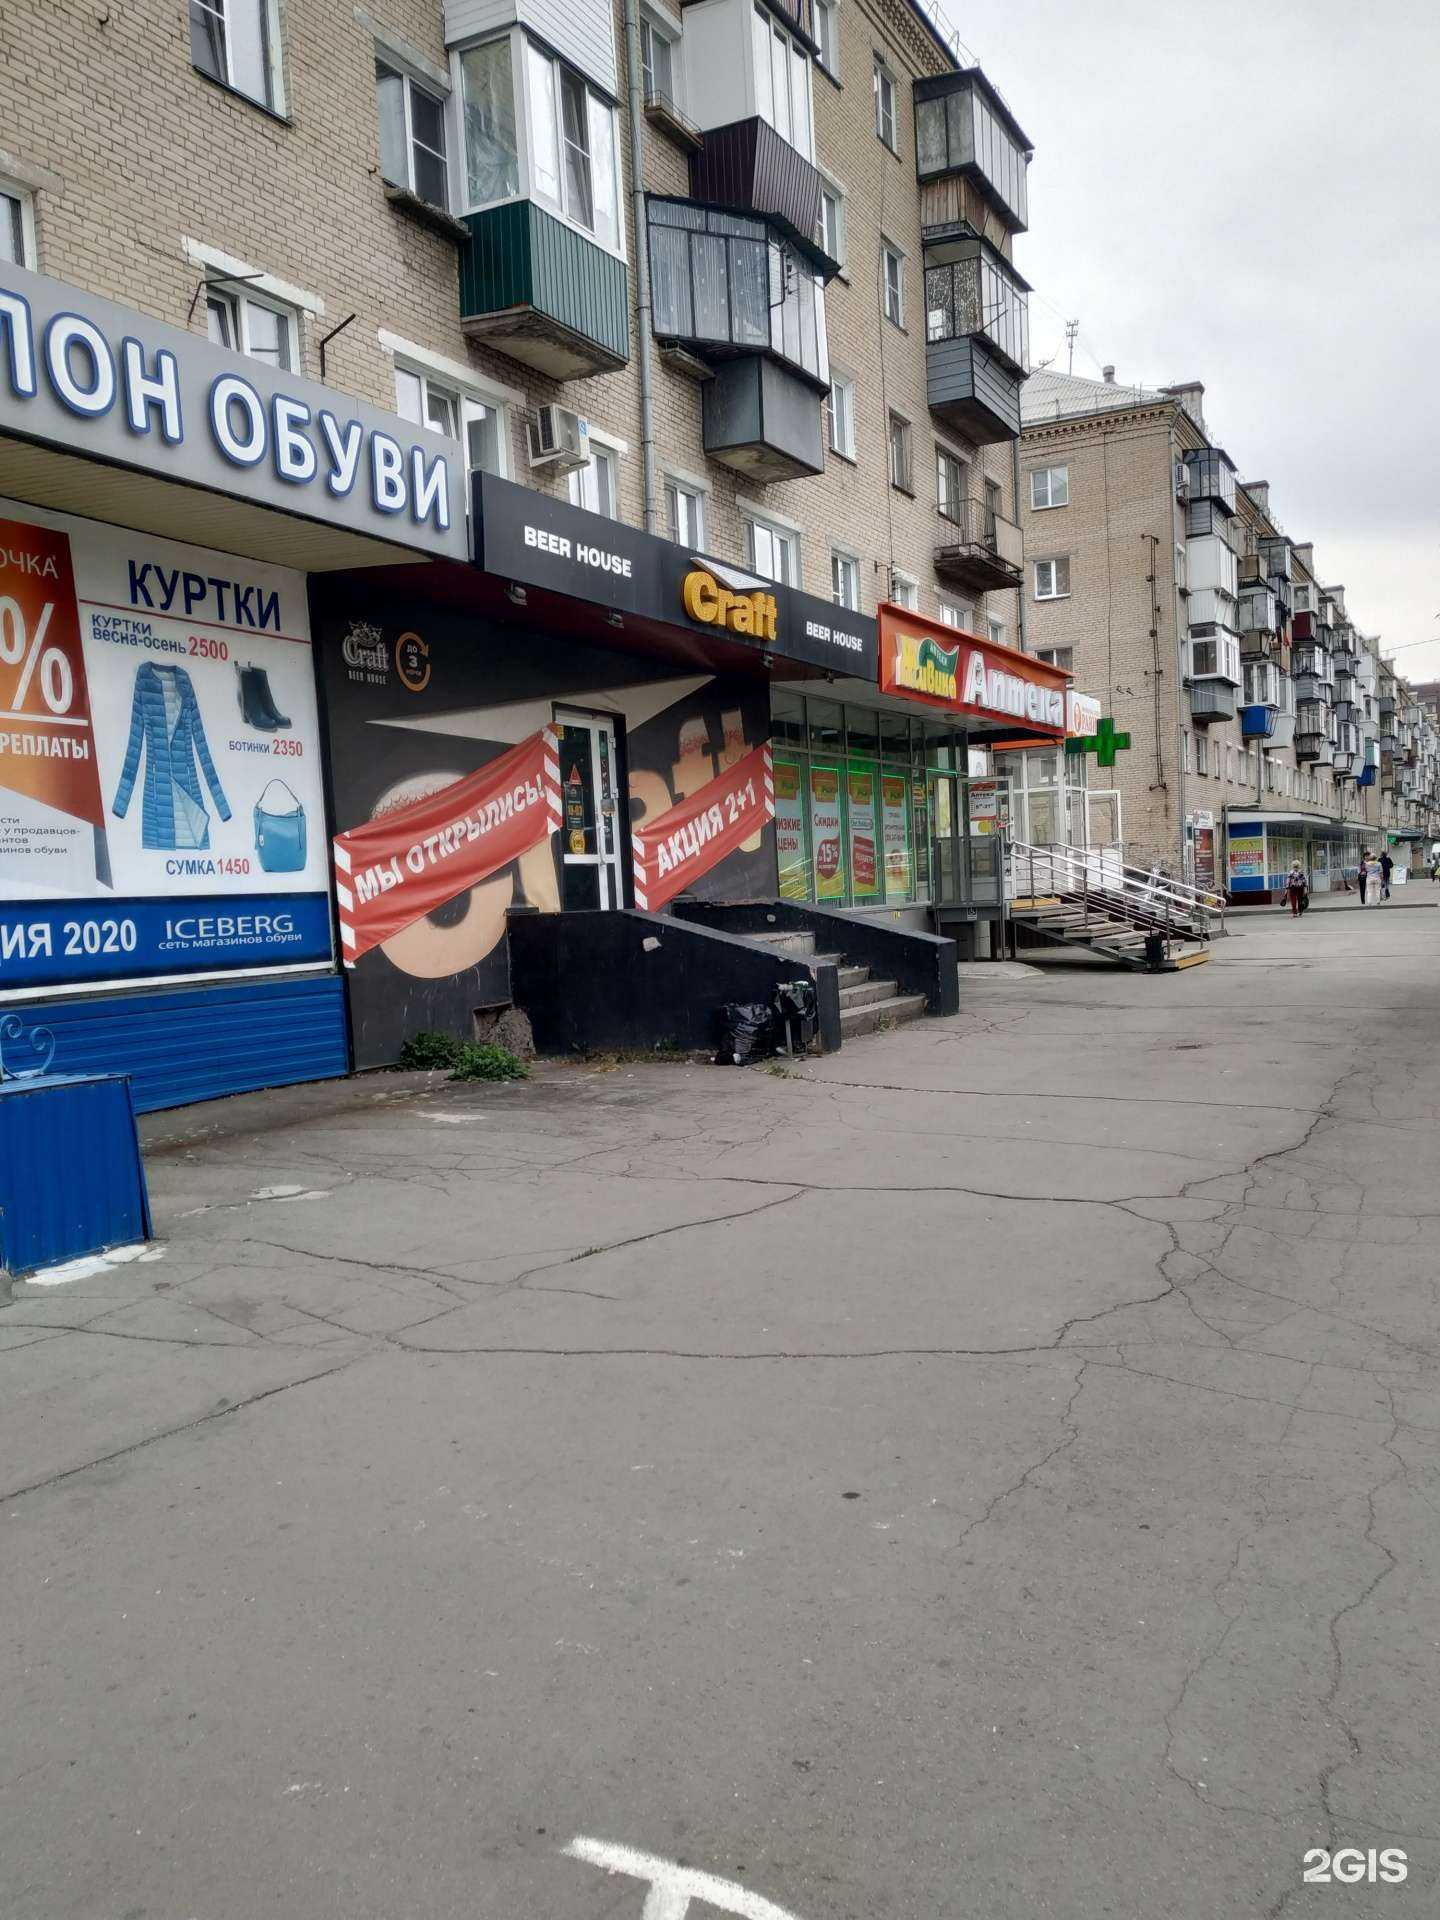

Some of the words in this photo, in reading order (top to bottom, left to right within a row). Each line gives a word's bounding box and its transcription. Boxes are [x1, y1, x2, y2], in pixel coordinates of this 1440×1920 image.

[209, 372, 450, 531] ОБУВИ
[524, 525, 571, 558] BEER
[576, 543, 632, 578] HOUSE
[128, 559, 281, 631] КУРТКИ
[682, 571, 777, 641] Craft
[92, 614, 152, 635] КУРТКИ
[806, 620, 831, 642] BEER
[833, 629, 863, 652] HOUSE
[188, 636, 229, 660] 2500
[963, 651, 1065, 728] Аптека
[229, 740, 270, 754] БОТИНКИ
[272, 738, 303, 757] 2350
[354, 856, 404, 905] МЫ
[406, 774, 546, 874] ОТКРЫЛИСЬ!
[657, 803, 723, 878] АКЦИЯ
[725, 778, 756, 824] 2+1
[166, 860, 215, 876] СУМКА
[217, 858, 250, 875] 1450
[63, 919, 137, 955] 2020
[158, 940, 189, 950] сеть
[193, 935, 263, 948] магазинов
[266, 932, 302, 943] обуви
[166, 915, 293, 939] ICEBERG
